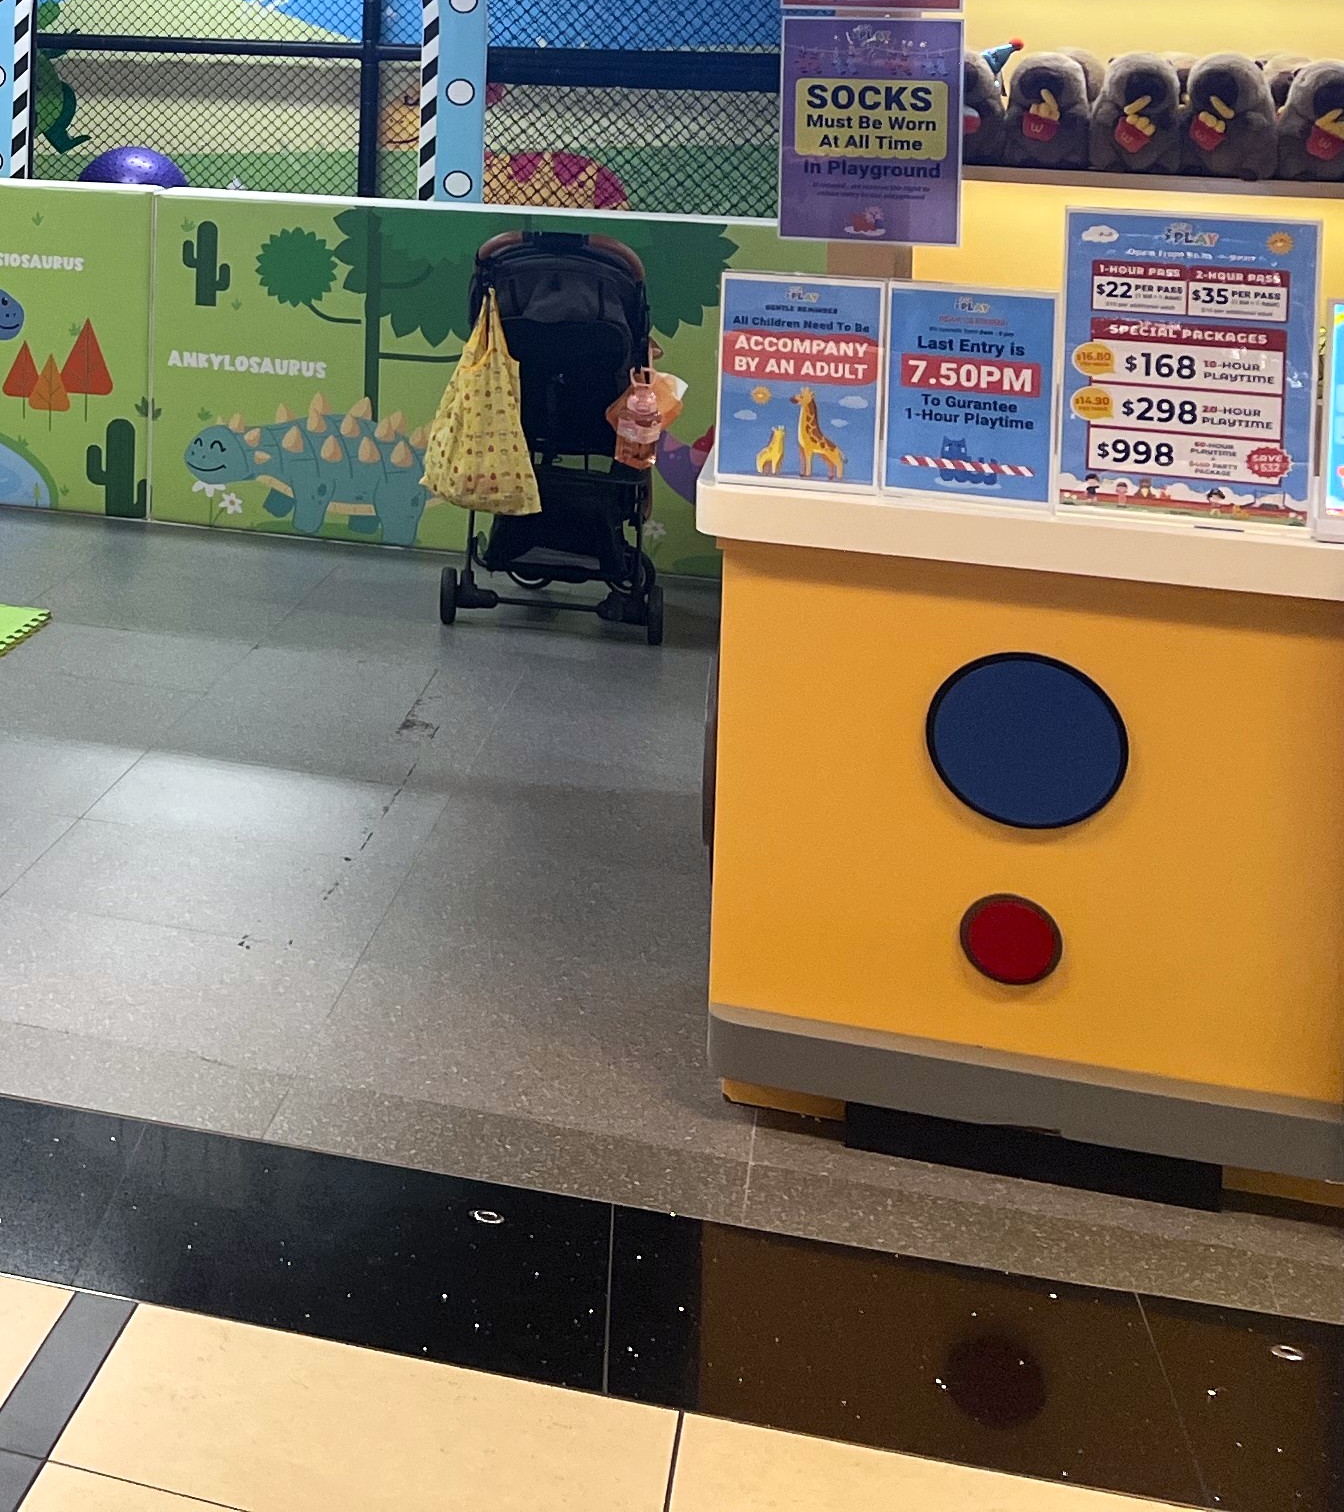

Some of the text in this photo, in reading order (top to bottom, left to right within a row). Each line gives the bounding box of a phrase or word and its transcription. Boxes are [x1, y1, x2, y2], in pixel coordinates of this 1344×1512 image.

[806, 84, 933, 112] SOCKS
[807, 114, 937, 131] Must Be Worn
[818, 134, 923, 151] At All Time
[804, 159, 941, 179] In Playground
[1099, 264, 1181, 278] 1-HOUR PASS
[1195, 270, 1281, 284] 2-HOUR PASS
[1096, 281, 1133, 298] $22
[1134, 284, 1154, 292] PER
[1157, 285, 1184, 294] PASS
[1192, 288, 1229, 305] $35
[1231, 290, 1252, 298] PER
[1254, 291, 1281, 300] PASS
[733, 315, 870, 333] All Children Need To Be
[1109, 323, 1268, 345] SPECIAL PACKAGES
[734, 334, 869, 358] ACCOMPANY
[917, 335, 1025, 359] Last Entry is
[167, 349, 328, 379] ANKYLOSAURUS
[734, 356, 868, 379] BY AN ADULT
[1124, 352, 1196, 379] $168
[1203, 360, 1261, 372] 10-HOUR
[908, 359, 1033, 392] 7.50PM
[1203, 371, 1275, 385] PLAYTIME
[921, 393, 1018, 413] To Gurantee
[1121, 397, 1198, 425] $298
[1202, 405, 1261, 417] 20-HOUR
[905, 407, 1034, 430] 1-Hour Playtime
[1201, 416, 1273, 430] PLAYTIME
[1097, 438, 1175, 467] $998
[1252, 454, 1283, 463] SAVE
